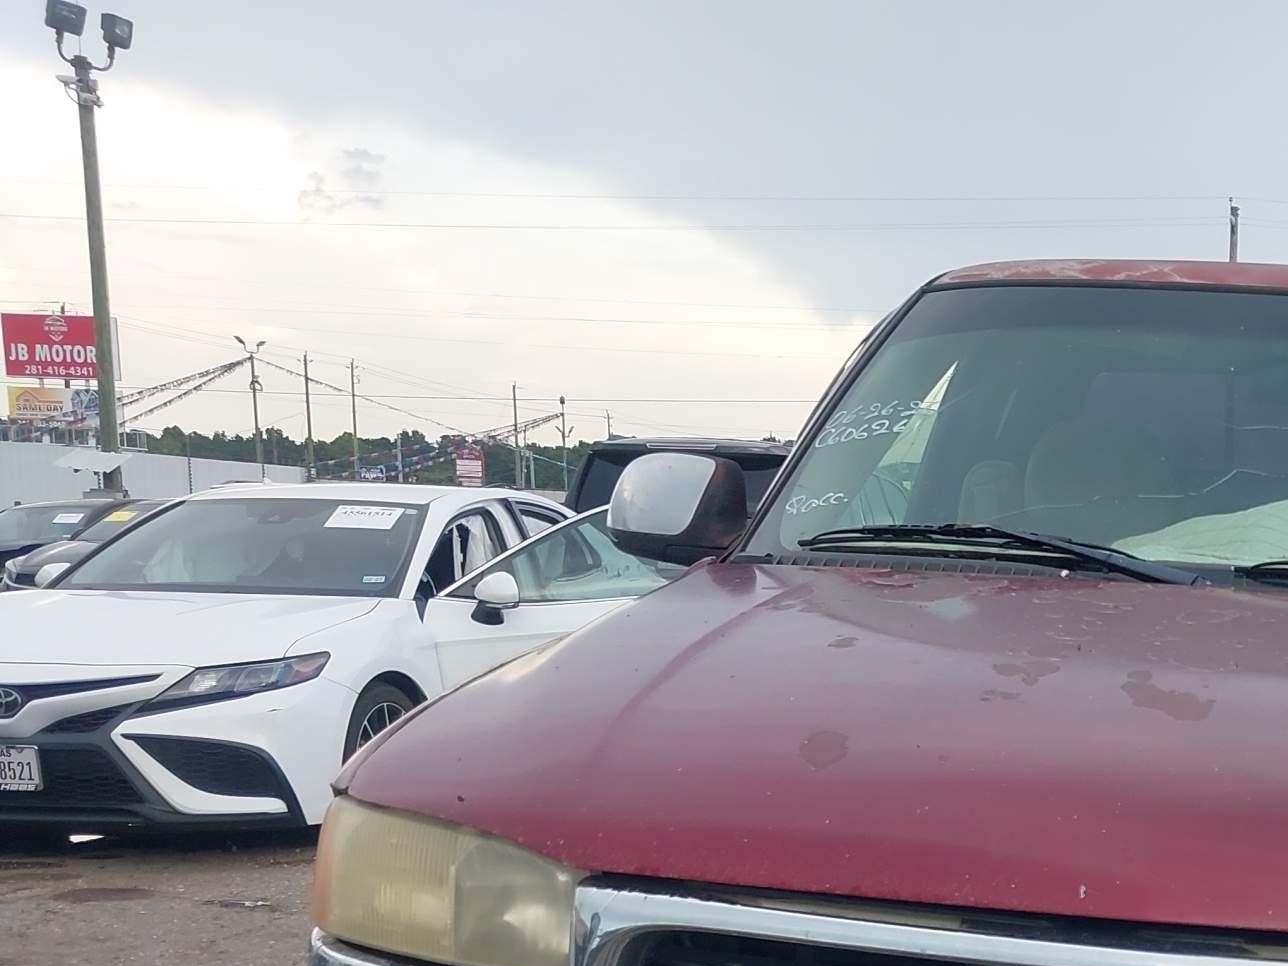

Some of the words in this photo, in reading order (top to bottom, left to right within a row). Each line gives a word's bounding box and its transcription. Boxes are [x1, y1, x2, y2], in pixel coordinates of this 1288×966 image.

[9, 343, 29, 361] JB
[24, 365, 93, 377] 281-416-4341
[0, 761, 35, 781] 8521
